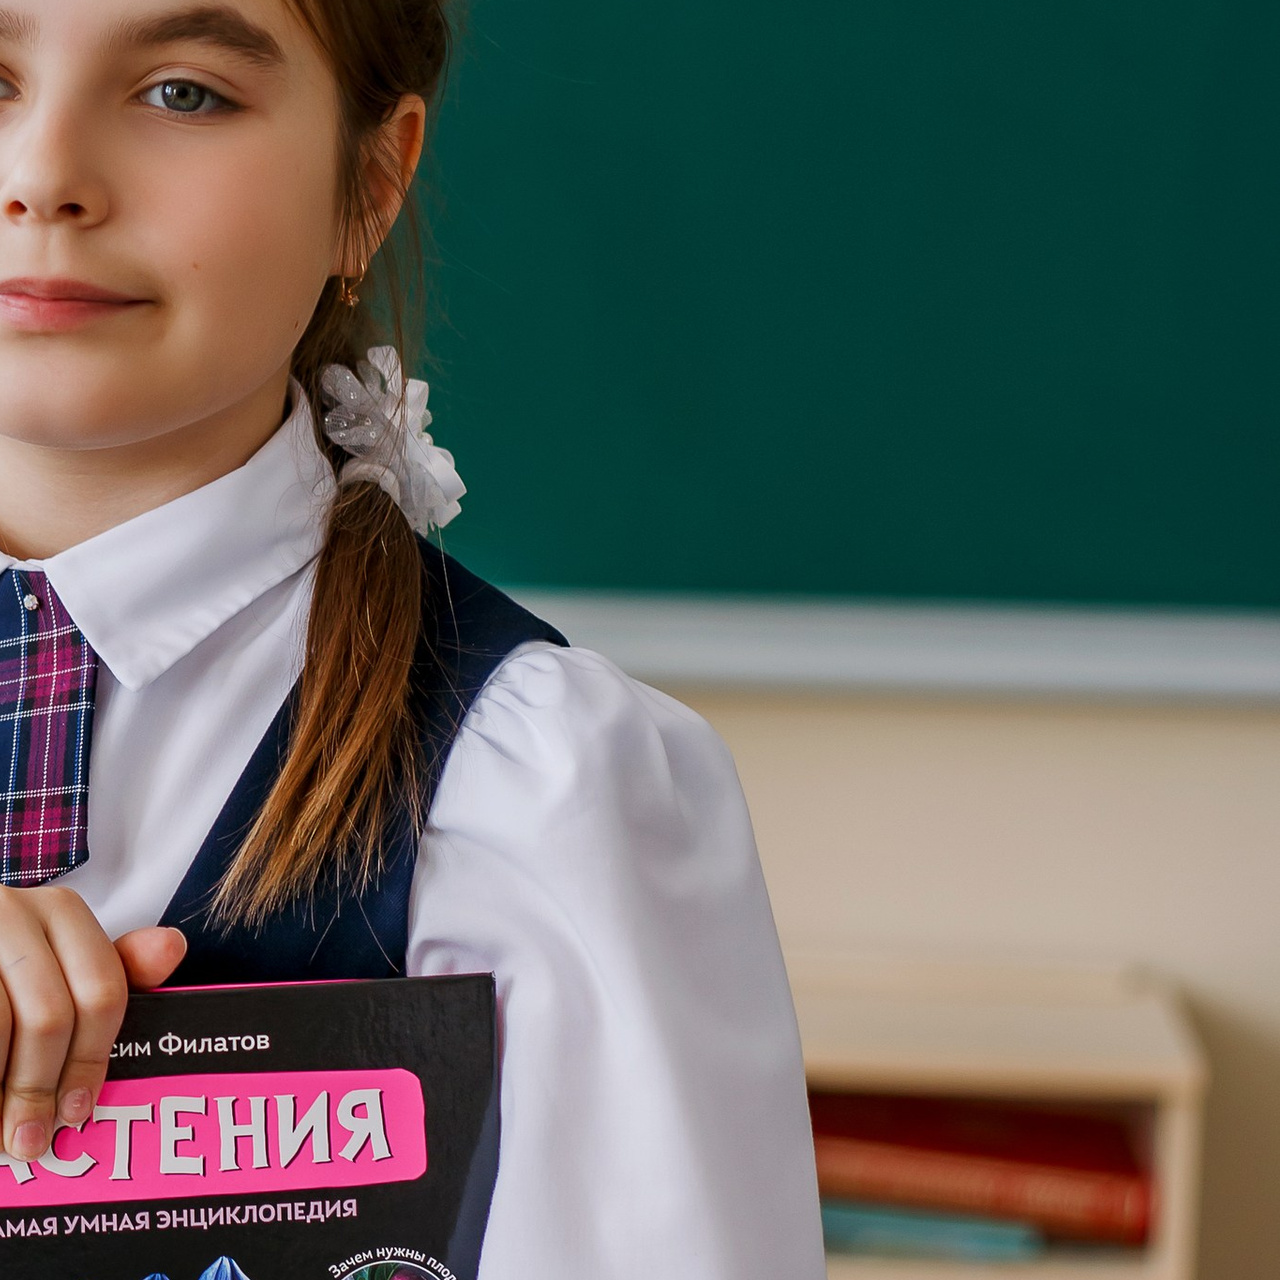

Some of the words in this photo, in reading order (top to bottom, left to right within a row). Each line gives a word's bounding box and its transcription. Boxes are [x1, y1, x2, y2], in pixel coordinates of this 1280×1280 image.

[158, 1031, 271, 1057] Филатов
[63, 1211, 151, 1236] УМНАЯ
[156, 1198, 358, 1231] ЭНЦИКЛОПЕДИЯ
[328, 1249, 373, 1279] Зачем
[376, 1246, 426, 1263] нужны
